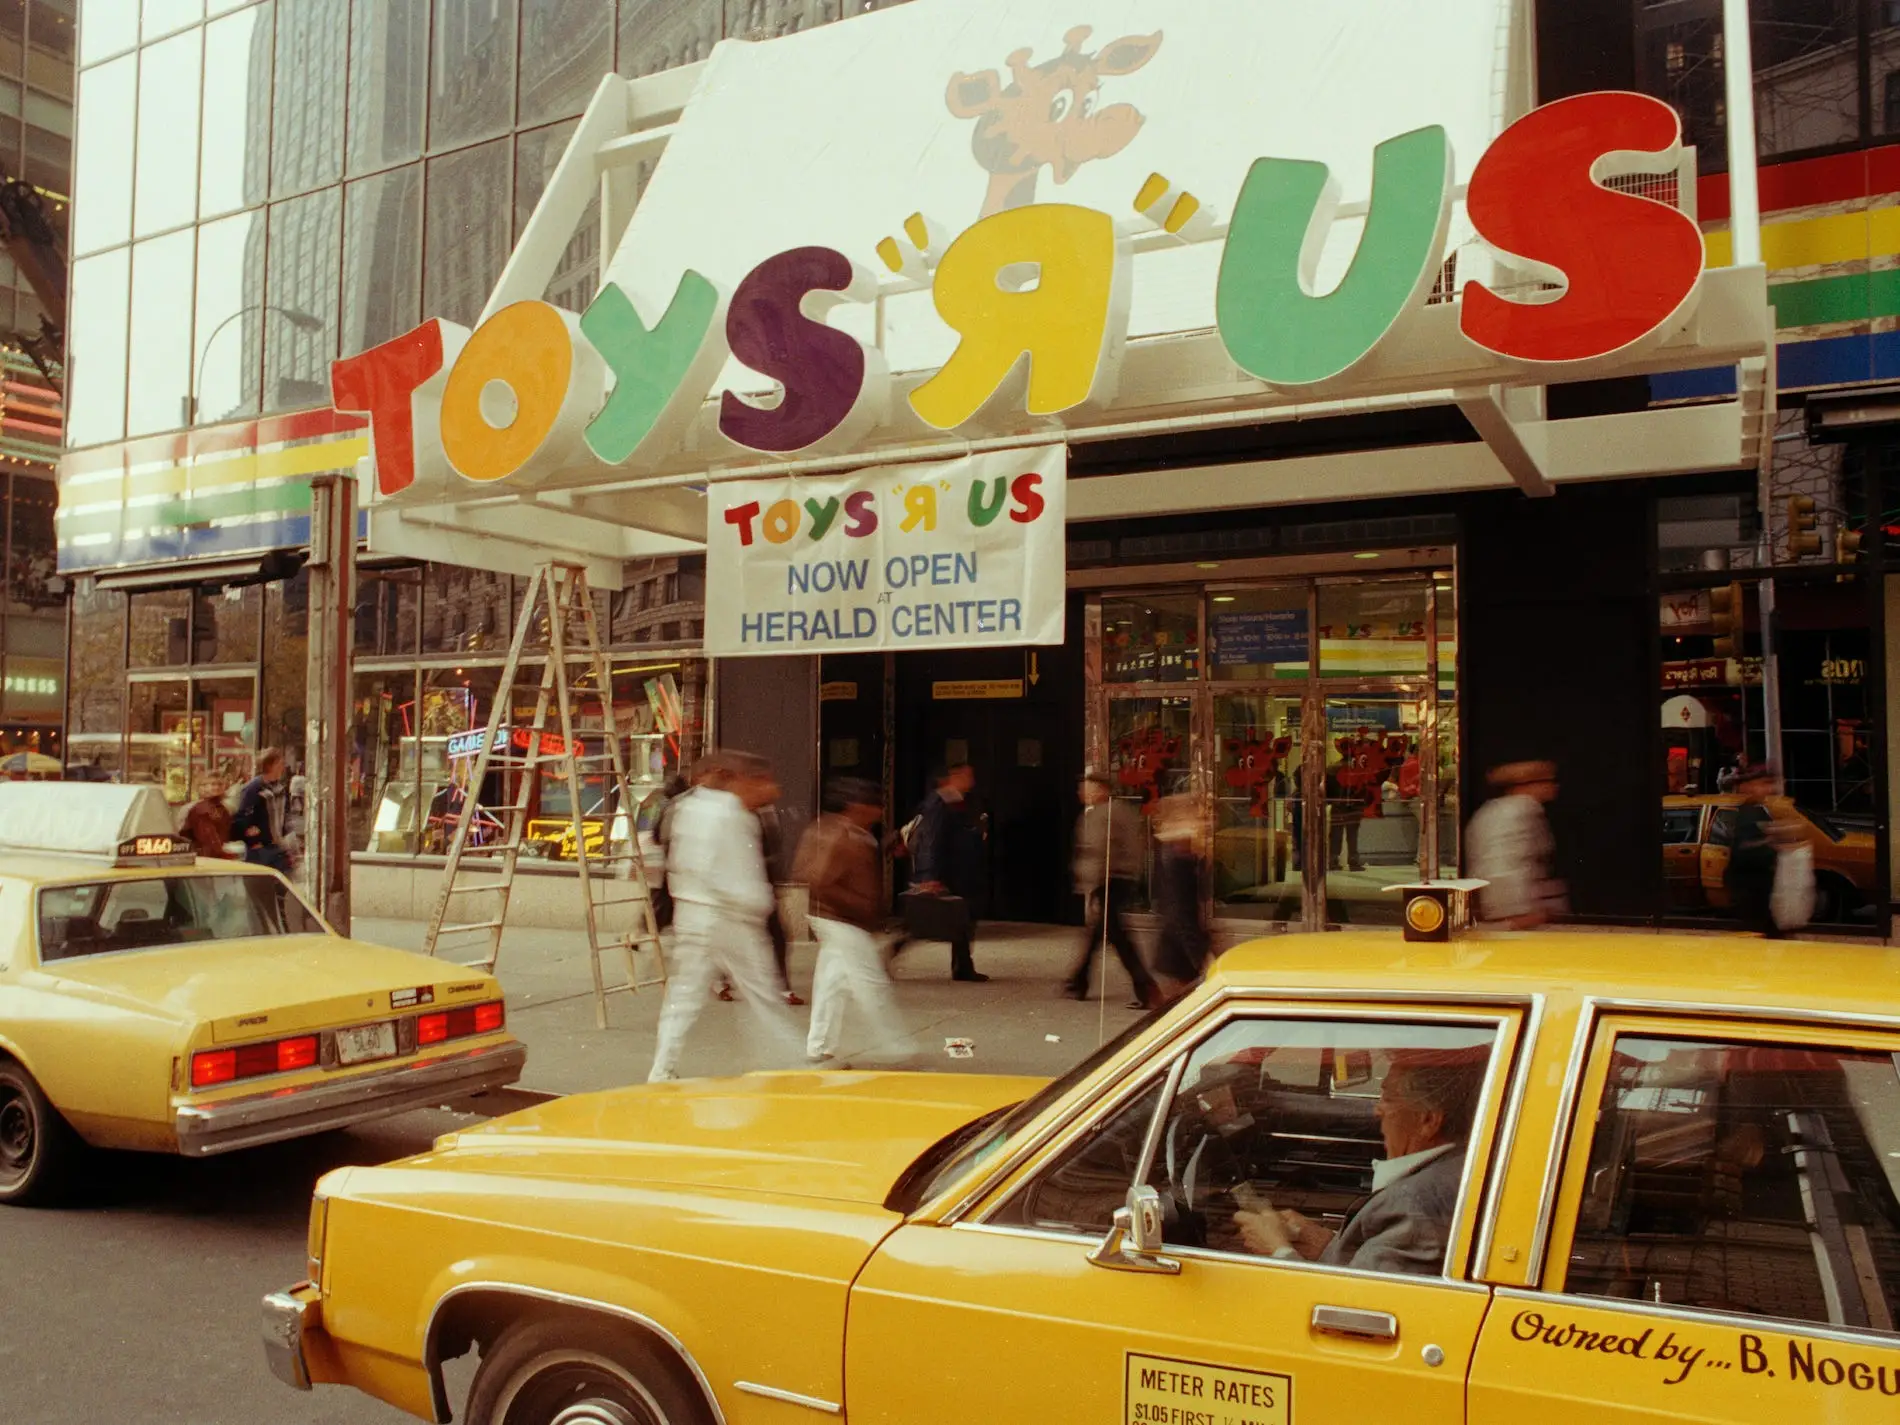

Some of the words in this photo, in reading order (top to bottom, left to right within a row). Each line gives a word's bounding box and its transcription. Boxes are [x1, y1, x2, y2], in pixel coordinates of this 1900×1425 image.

[331, 245, 867, 497] TOYS
[1216, 89, 1706, 386] US
[724, 490, 879, 547] TOYS
[967, 472, 1046, 528] US
[787, 559, 870, 595] NOW
[885, 551, 978, 590] OPEN
[876, 590, 895, 605] AT
[740, 607, 878, 644] HERALD
[891, 597, 1022, 638] CENTER
[1511, 1309, 1654, 1360] Owned
[1740, 1333, 1776, 1378] B.
[1140, 1367, 1205, 1398] METER
[1213, 1378, 1276, 1409] RATES
[1134, 1402, 1169, 1424] $1.05
[1171, 1408, 1215, 1425] FIRST
